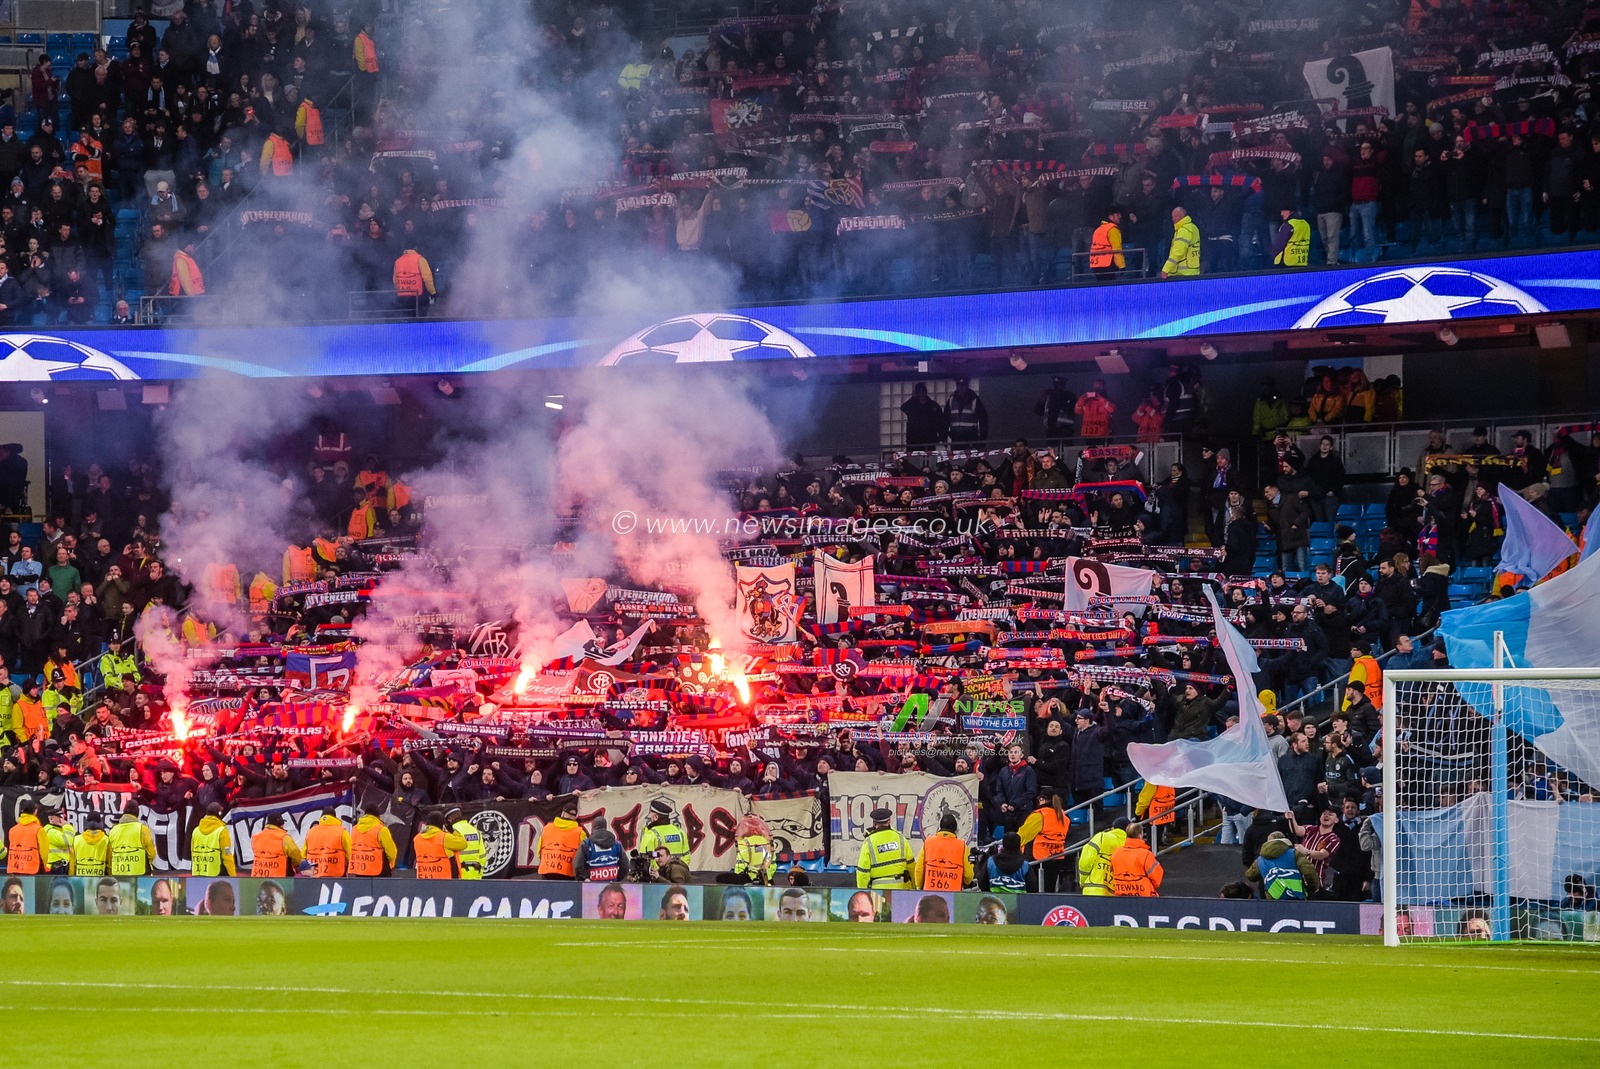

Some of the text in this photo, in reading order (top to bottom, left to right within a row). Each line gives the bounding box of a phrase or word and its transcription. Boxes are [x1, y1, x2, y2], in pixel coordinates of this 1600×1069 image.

[1122, 101, 1148, 110] BASEL
[1092, 448, 1124, 457] BASEL
[1003, 528, 1066, 539] FANATICS
[940, 565, 998, 577] FANATICS
[935, 620, 983, 632] Hopp FCB
[603, 700, 669, 711] FANATICS
[829, 711, 870, 721] FC BASEL
[986, 719, 1000, 727] THE
[443, 723, 506, 737] INFERNO BASEL
[630, 730, 701, 743] FANATICS
[495, 748, 531, 756] INFERNO
[635, 744, 709, 755] FANATICS
[67, 810, 119, 836] BOS
[351, 854, 375, 862] EWARD
[544, 853, 572, 864] TEWARD
[254, 861, 279, 869] EWARD
[418, 865, 442, 873] EWARD
[590, 867, 618, 879] PHOTO
[927, 869, 957, 880] TEWARD
[931, 879, 950, 889] 566
[1116, 884, 1144, 892] TEWARD
[1050, 908, 1080, 925] UEFA
